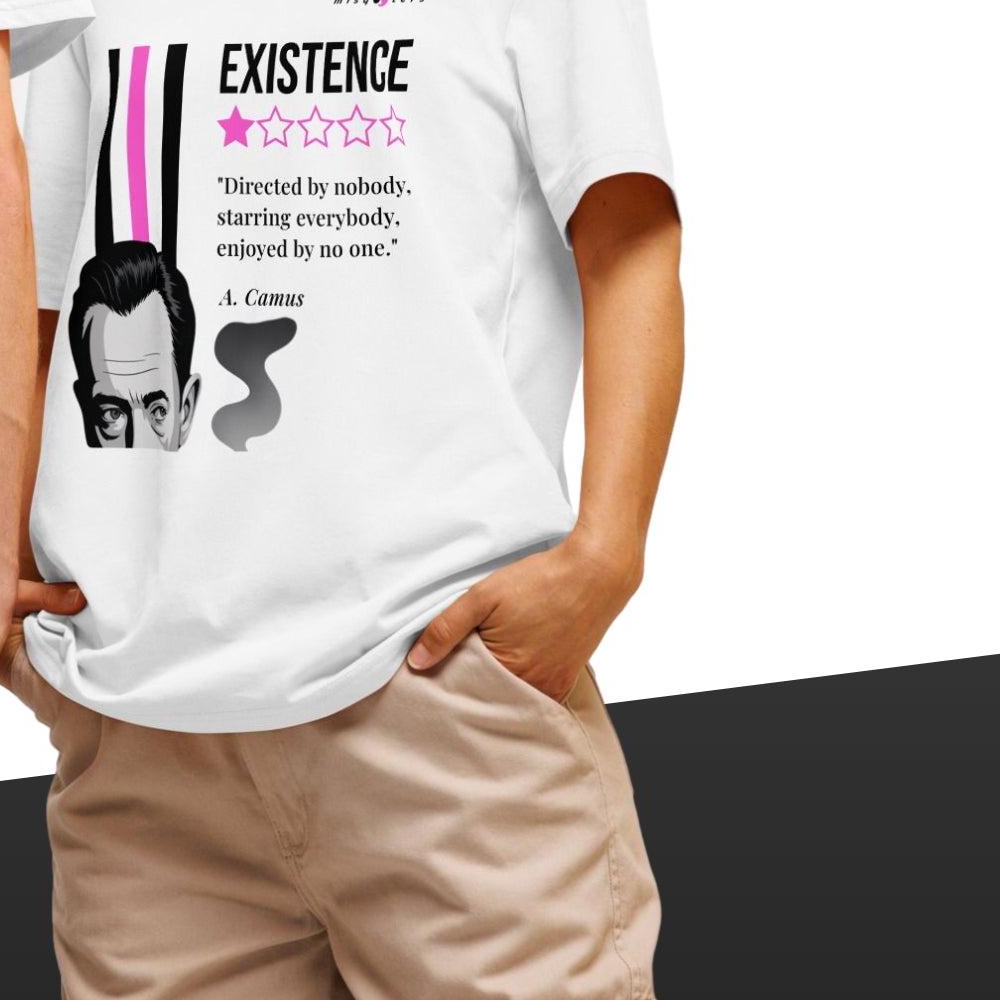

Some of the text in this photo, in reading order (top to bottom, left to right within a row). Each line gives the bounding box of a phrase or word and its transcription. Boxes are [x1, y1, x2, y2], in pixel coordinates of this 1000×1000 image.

[218, 38, 415, 95] EXISTENCE
[217, 175, 412, 201] "Directed by nobody,
[216, 206, 401, 232] starring everybody,
[216, 237, 398, 263] enjoyed by no one."
[217, 288, 305, 308] A. Camus
